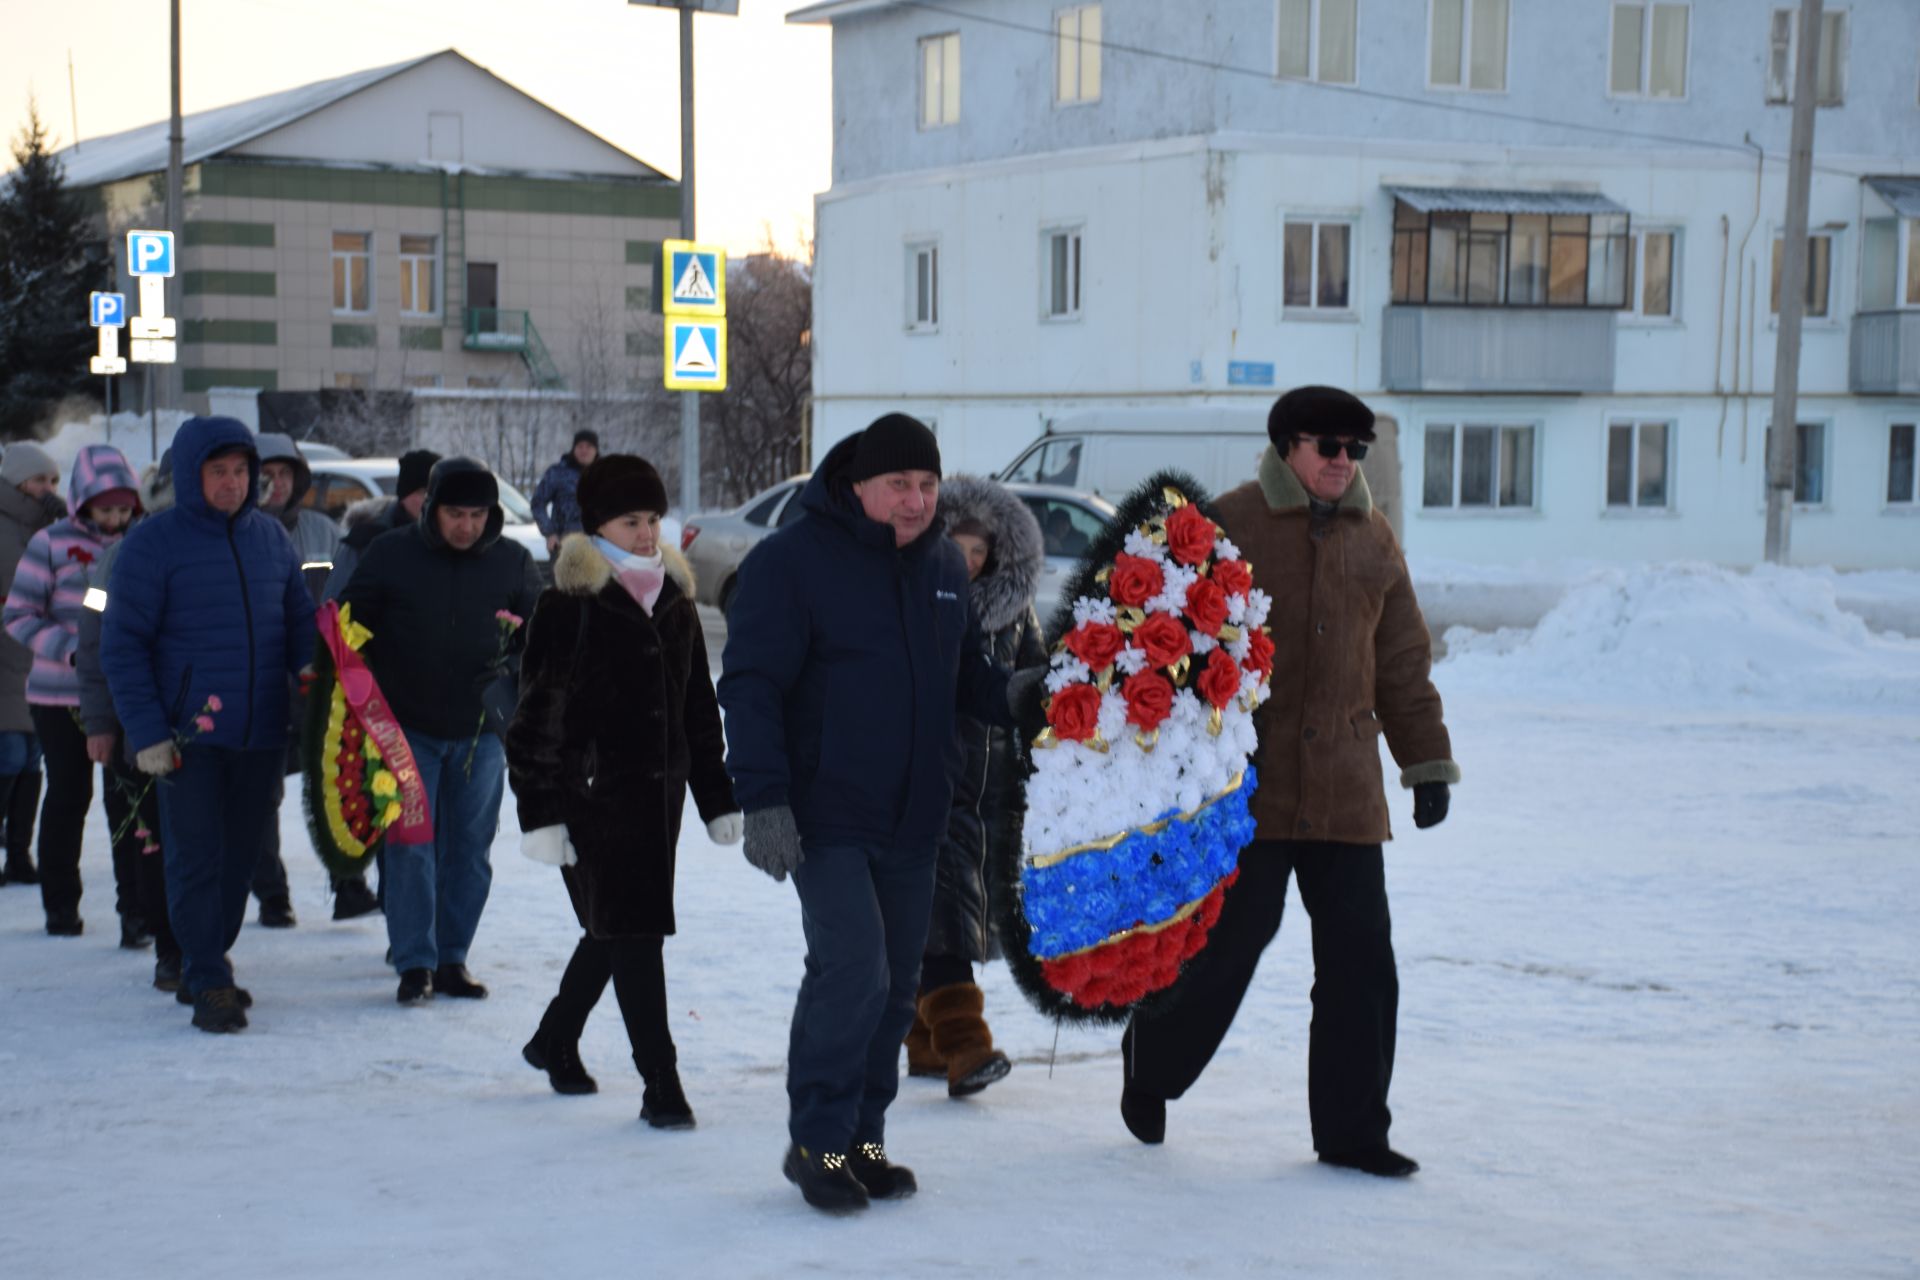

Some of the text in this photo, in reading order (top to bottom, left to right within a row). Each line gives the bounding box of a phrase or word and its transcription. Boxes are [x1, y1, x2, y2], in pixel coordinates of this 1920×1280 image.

[137, 236, 164, 271] P
[98, 296, 117, 323] P
[366, 699, 425, 828] ВЕЧНАЯ ПАМЯТЬ
